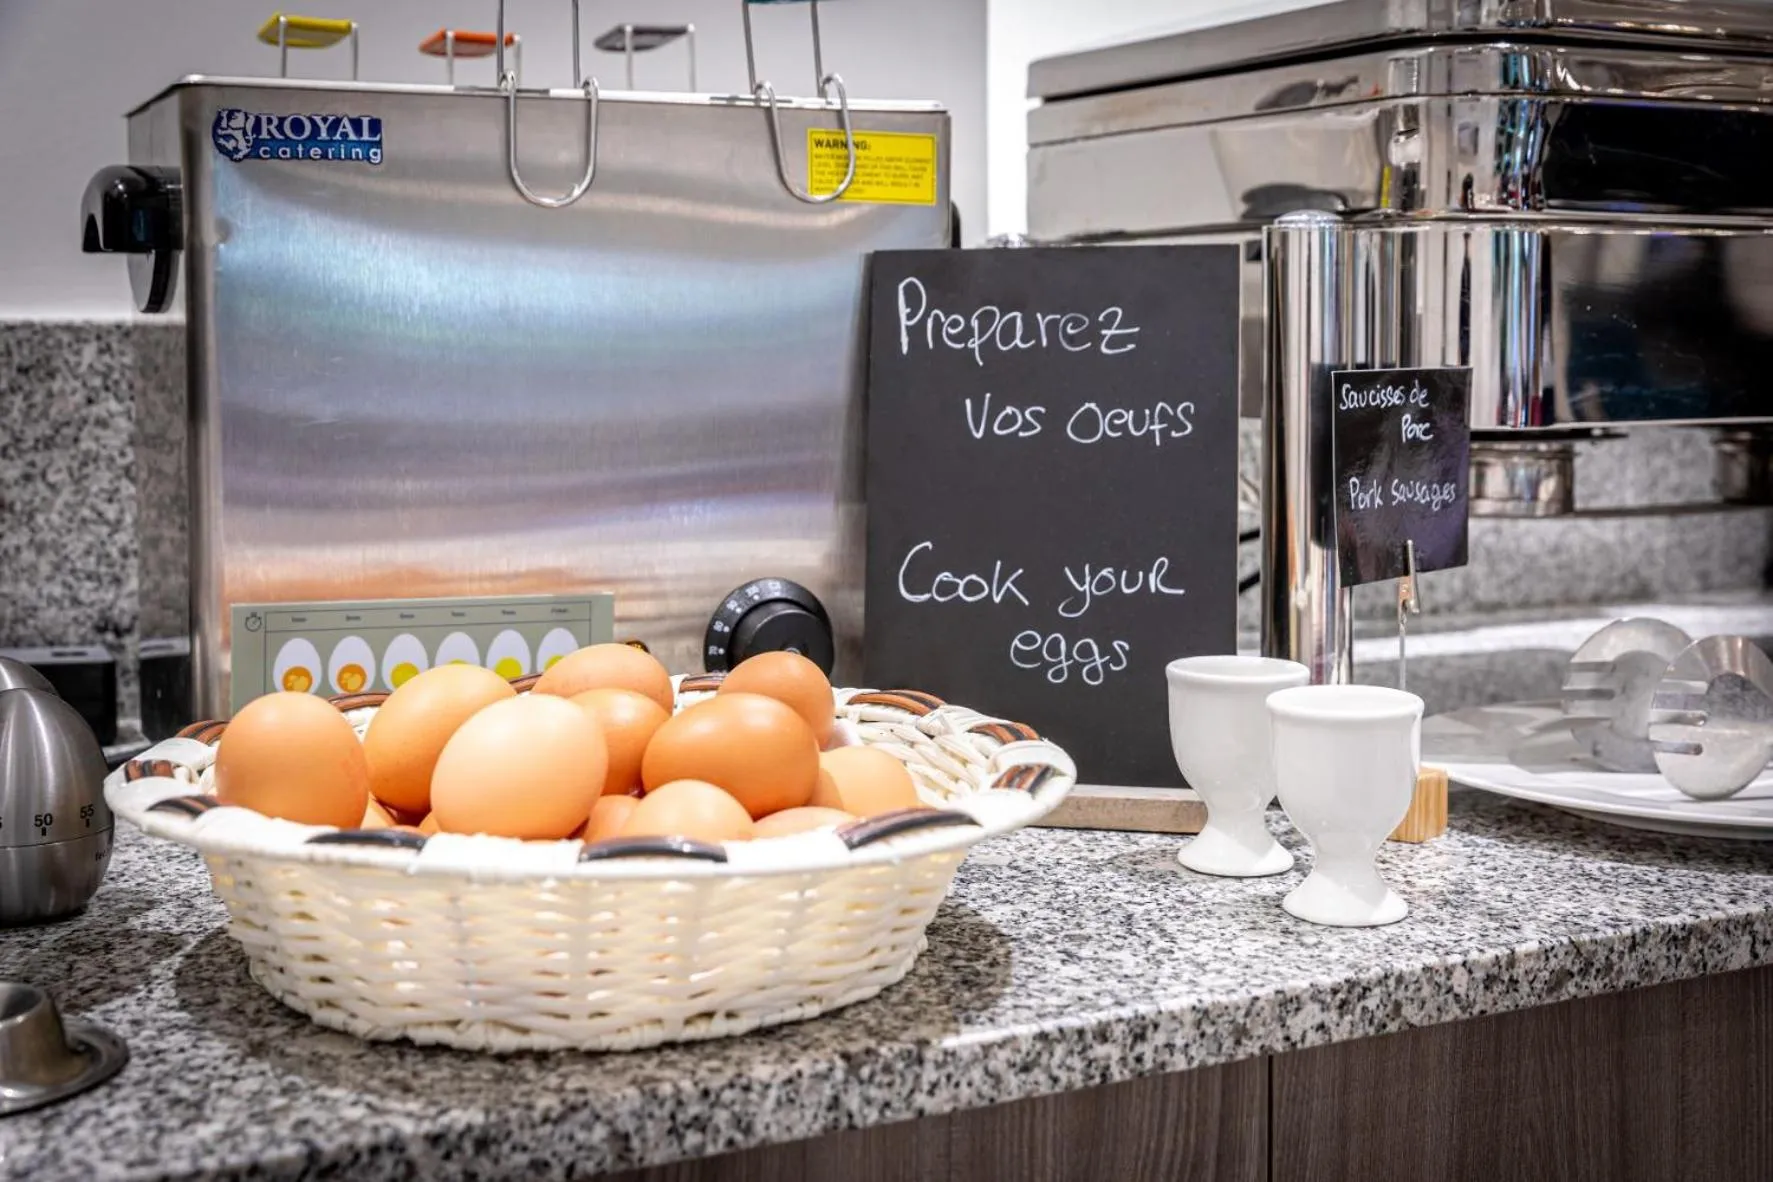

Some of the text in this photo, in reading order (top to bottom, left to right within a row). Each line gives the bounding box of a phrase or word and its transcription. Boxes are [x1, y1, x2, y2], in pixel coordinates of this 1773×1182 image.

[254, 115, 382, 141] ROYAL
[259, 144, 383, 164] catering
[814, 139, 871, 150] WARNNG:
[898, 276, 1140, 366] Preparez
[1339, 379, 1430, 410] Saucisses de
[965, 393, 1046, 439] Vos
[1401, 413, 1434, 443] Porc
[1349, 476, 1383, 509] Pork
[899, 541, 1029, 606] Cook
[1010, 630, 1129, 685] eggs
[34, 813, 53, 828] 50
[80, 803, 95, 819] 55
